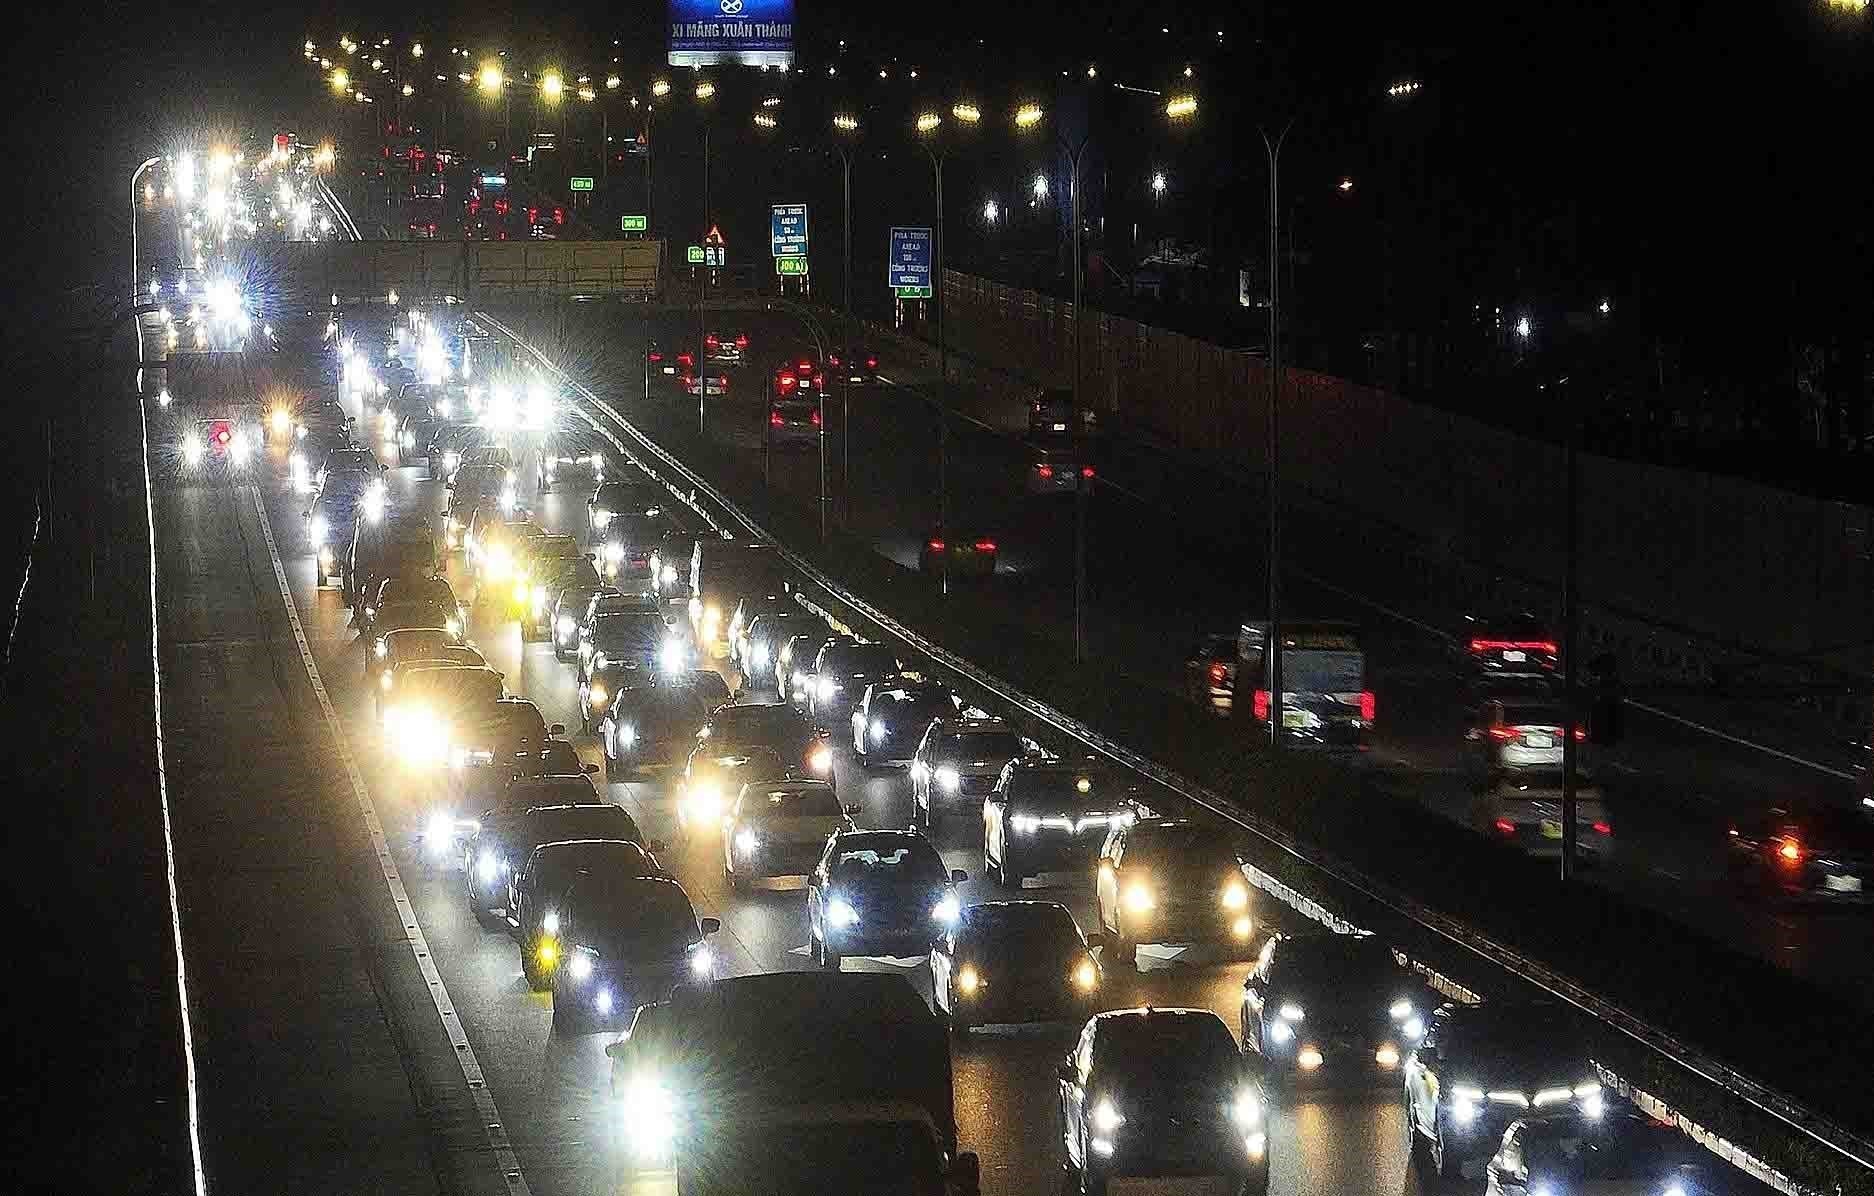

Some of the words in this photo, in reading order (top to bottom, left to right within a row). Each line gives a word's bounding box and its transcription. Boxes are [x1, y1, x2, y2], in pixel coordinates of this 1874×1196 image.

[672, 23, 683, 38] XI
[687, 20, 720, 38] MĂNG
[722, 20, 752, 38] XUÂN
[755, 20, 792, 38] THÀNH
